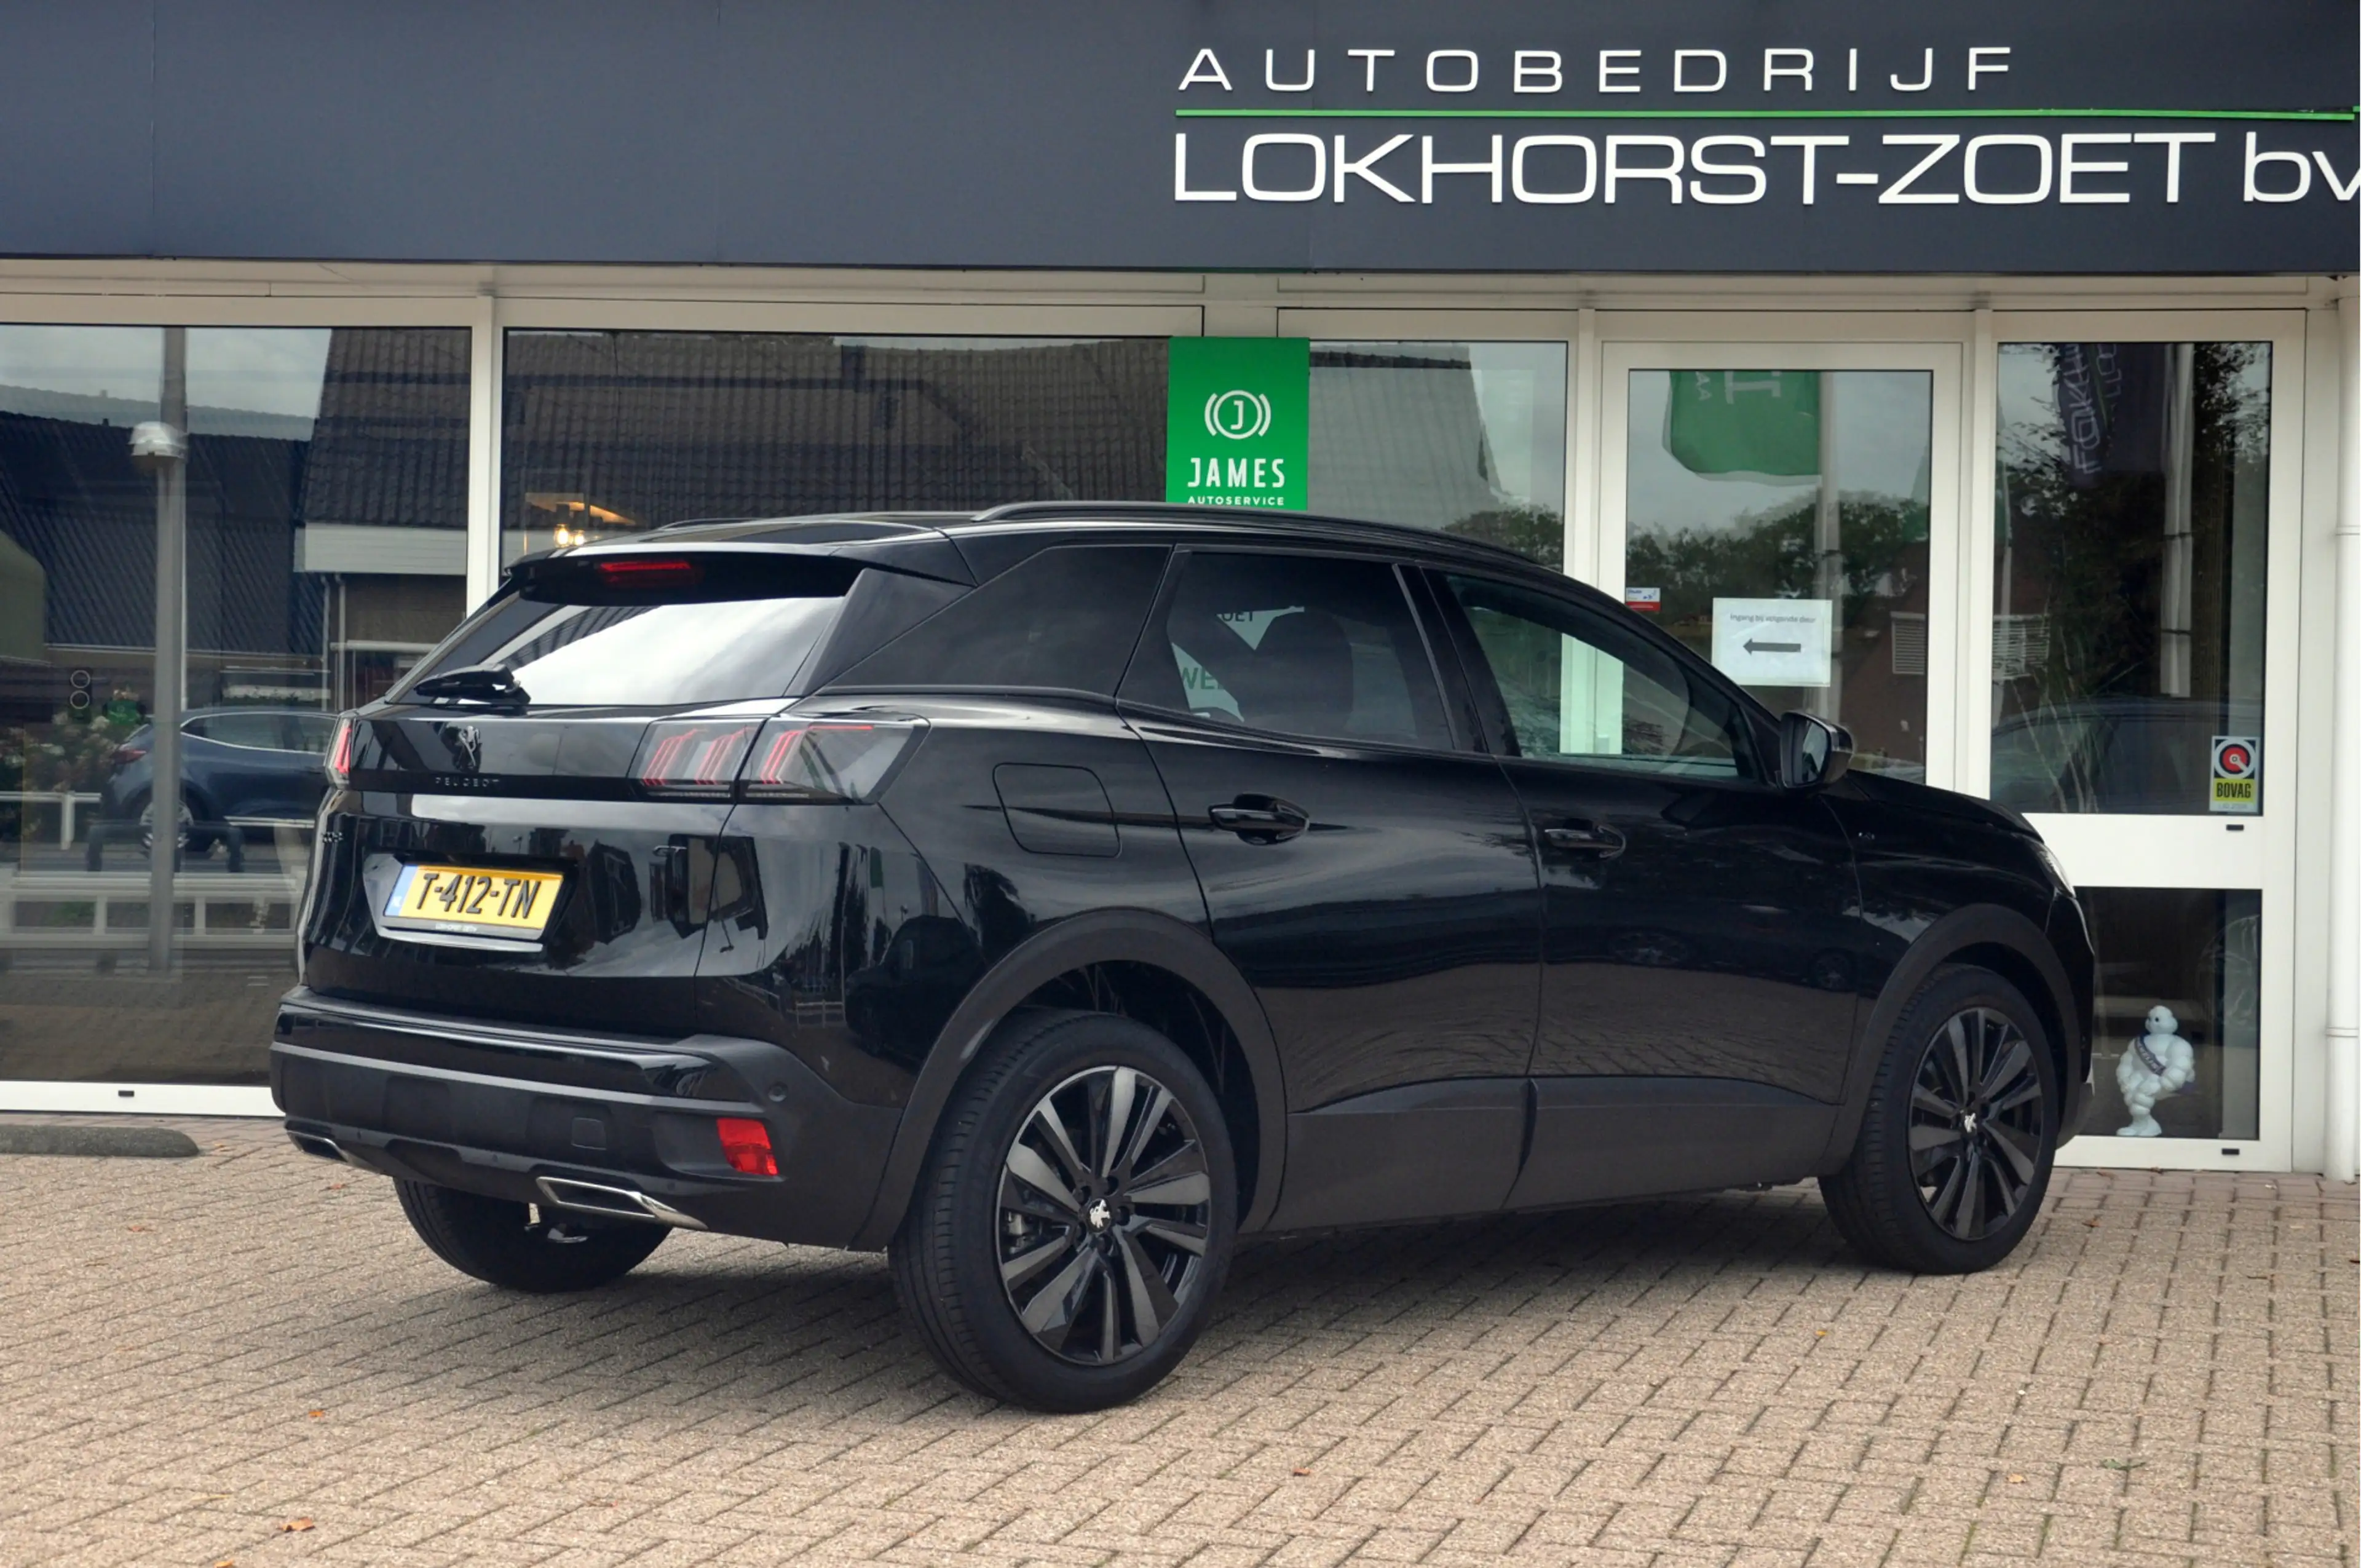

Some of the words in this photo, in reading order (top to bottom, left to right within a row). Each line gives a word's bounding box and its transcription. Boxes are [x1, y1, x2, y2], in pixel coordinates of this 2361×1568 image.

[1178, 47, 2011, 93] AUTOBEDRIJF
[1174, 132, 2217, 205] LOKHORST-ZOET
[2244, 132, 2360, 203] bv
[1187, 457, 1285, 488] JAMES
[1187, 496, 1284, 505] AUTOSERVICE
[2216, 782, 2252, 799] BOVAG
[416, 873, 542, 919] T-412-TN
